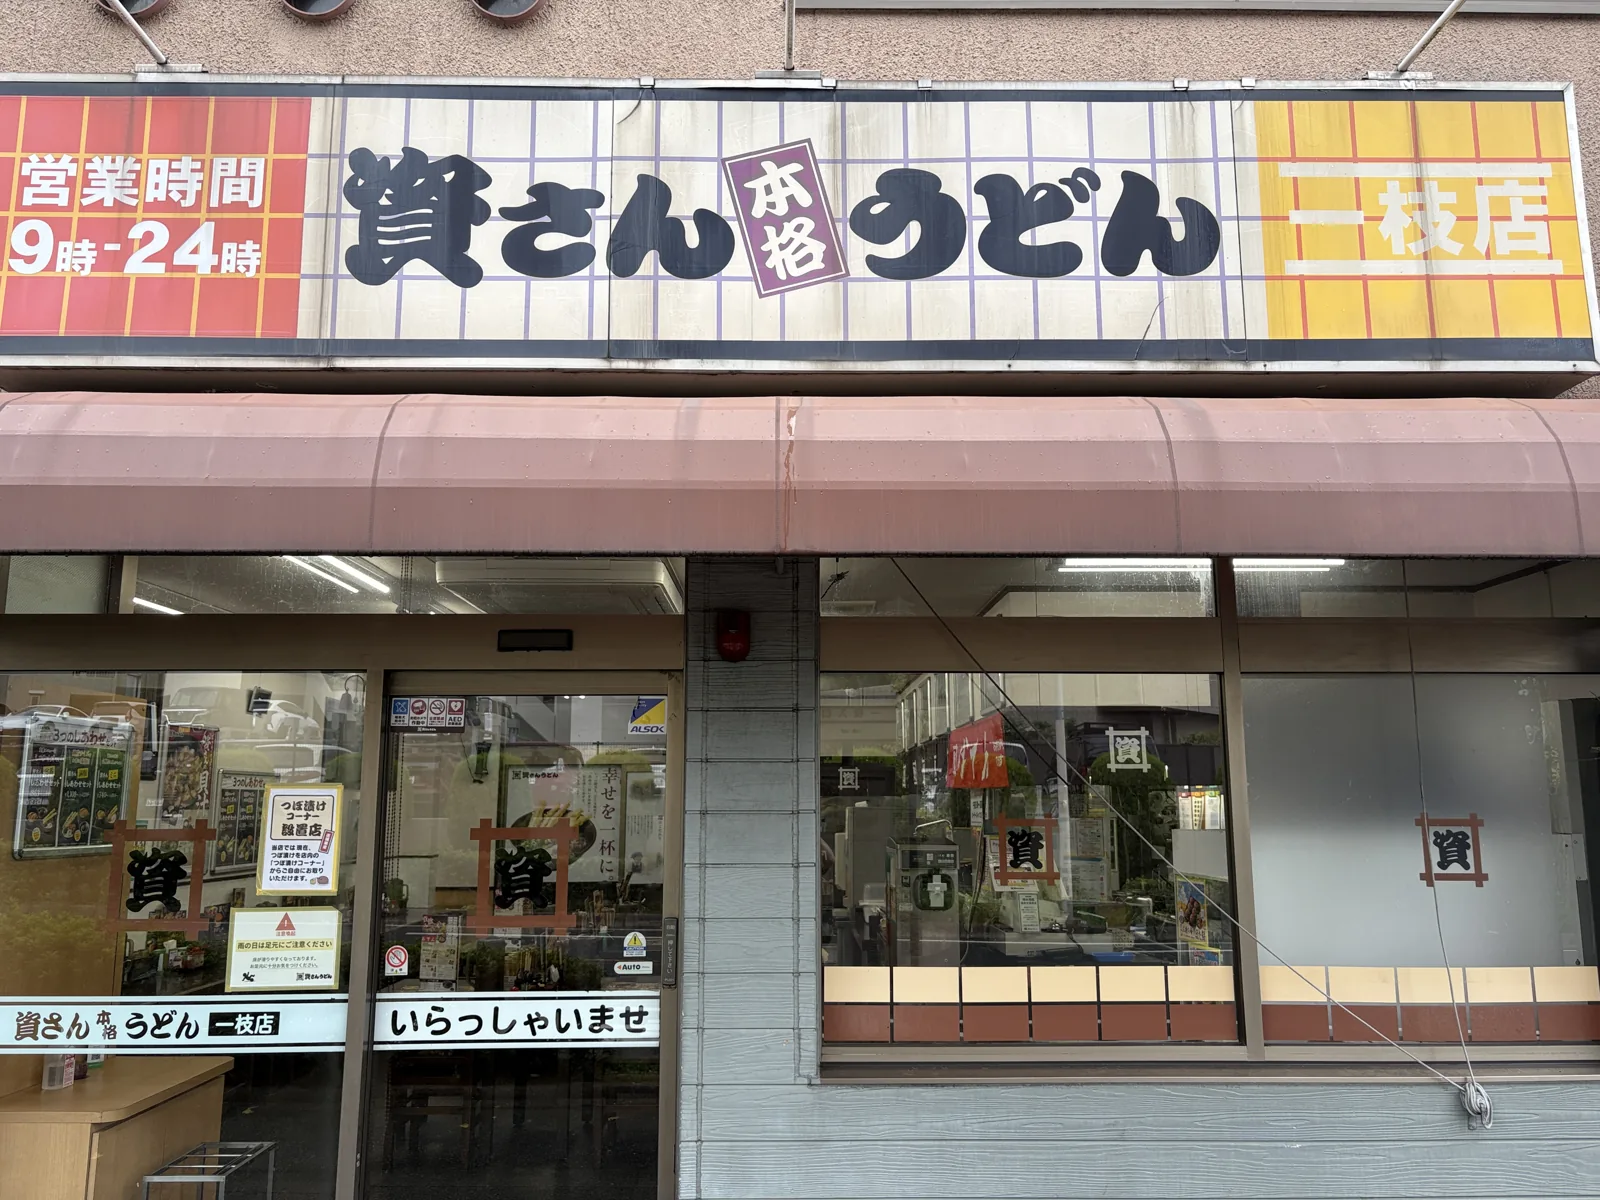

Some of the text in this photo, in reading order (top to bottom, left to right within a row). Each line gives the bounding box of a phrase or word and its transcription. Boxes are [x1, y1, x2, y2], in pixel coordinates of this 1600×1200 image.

[20, 154, 266, 208] 営業時間
[343, 146, 1221, 288] 資さん 本格 うどん
[630, 725, 665, 733] ALSOK
[1114, 736, 1141, 764] 資
[281, 800, 327, 812] つぼ漬け
[286, 812, 320, 821] コーナー
[281, 823, 322, 836] 設置店
[599, 767, 620, 882] 幸せを一杯に。
[1008, 829, 1044, 869] 資
[1433, 829, 1471, 870] 資
[126, 847, 187, 912] 資
[494, 846, 552, 910] 資
[237, 940, 333, 950] 雨の日は足元にご注意ください
[14, 1009, 275, 1041] 資さん 本格 うどん 一枝店
[391, 1004, 649, 1037] いらっしゃいませ
